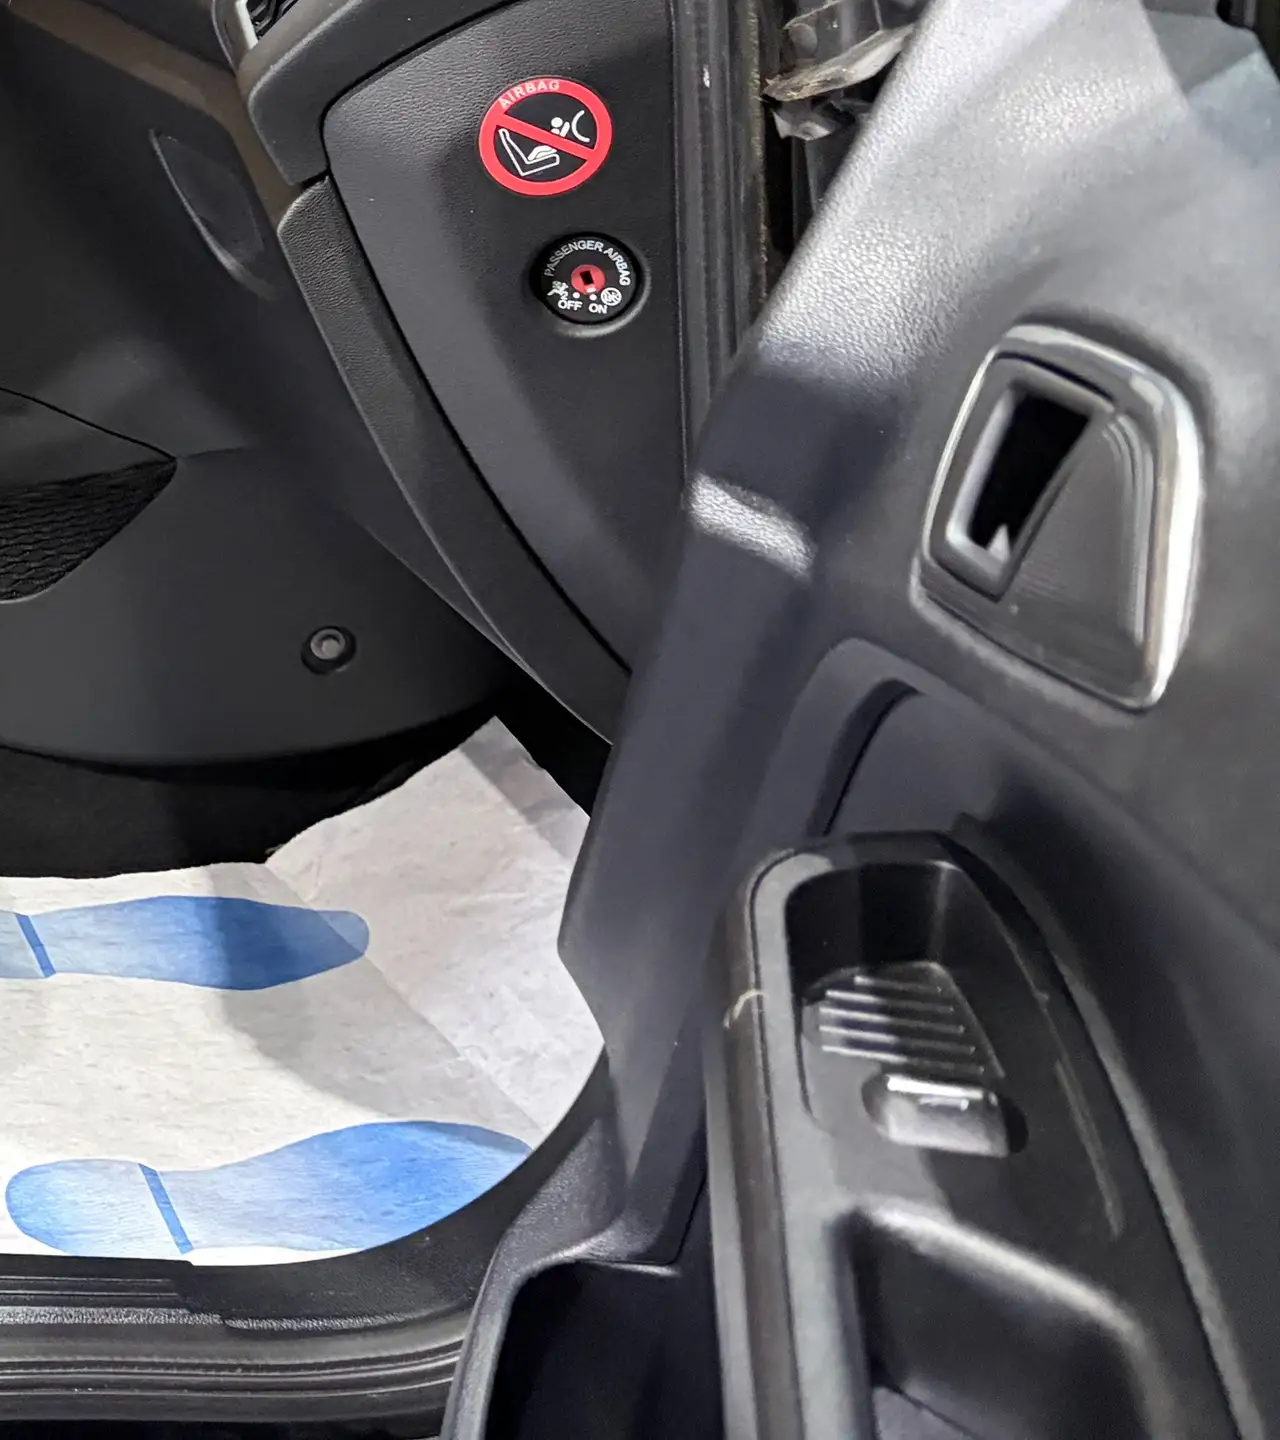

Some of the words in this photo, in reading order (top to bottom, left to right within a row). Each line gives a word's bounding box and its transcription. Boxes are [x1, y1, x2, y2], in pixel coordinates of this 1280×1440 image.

[498, 80, 560, 110] AIRBAG
[544, 240, 604, 277] PASSENGER
[603, 247, 631, 286] AIRBAG
[557, 300, 583, 311] OFF
[588, 303, 608, 314] ON
